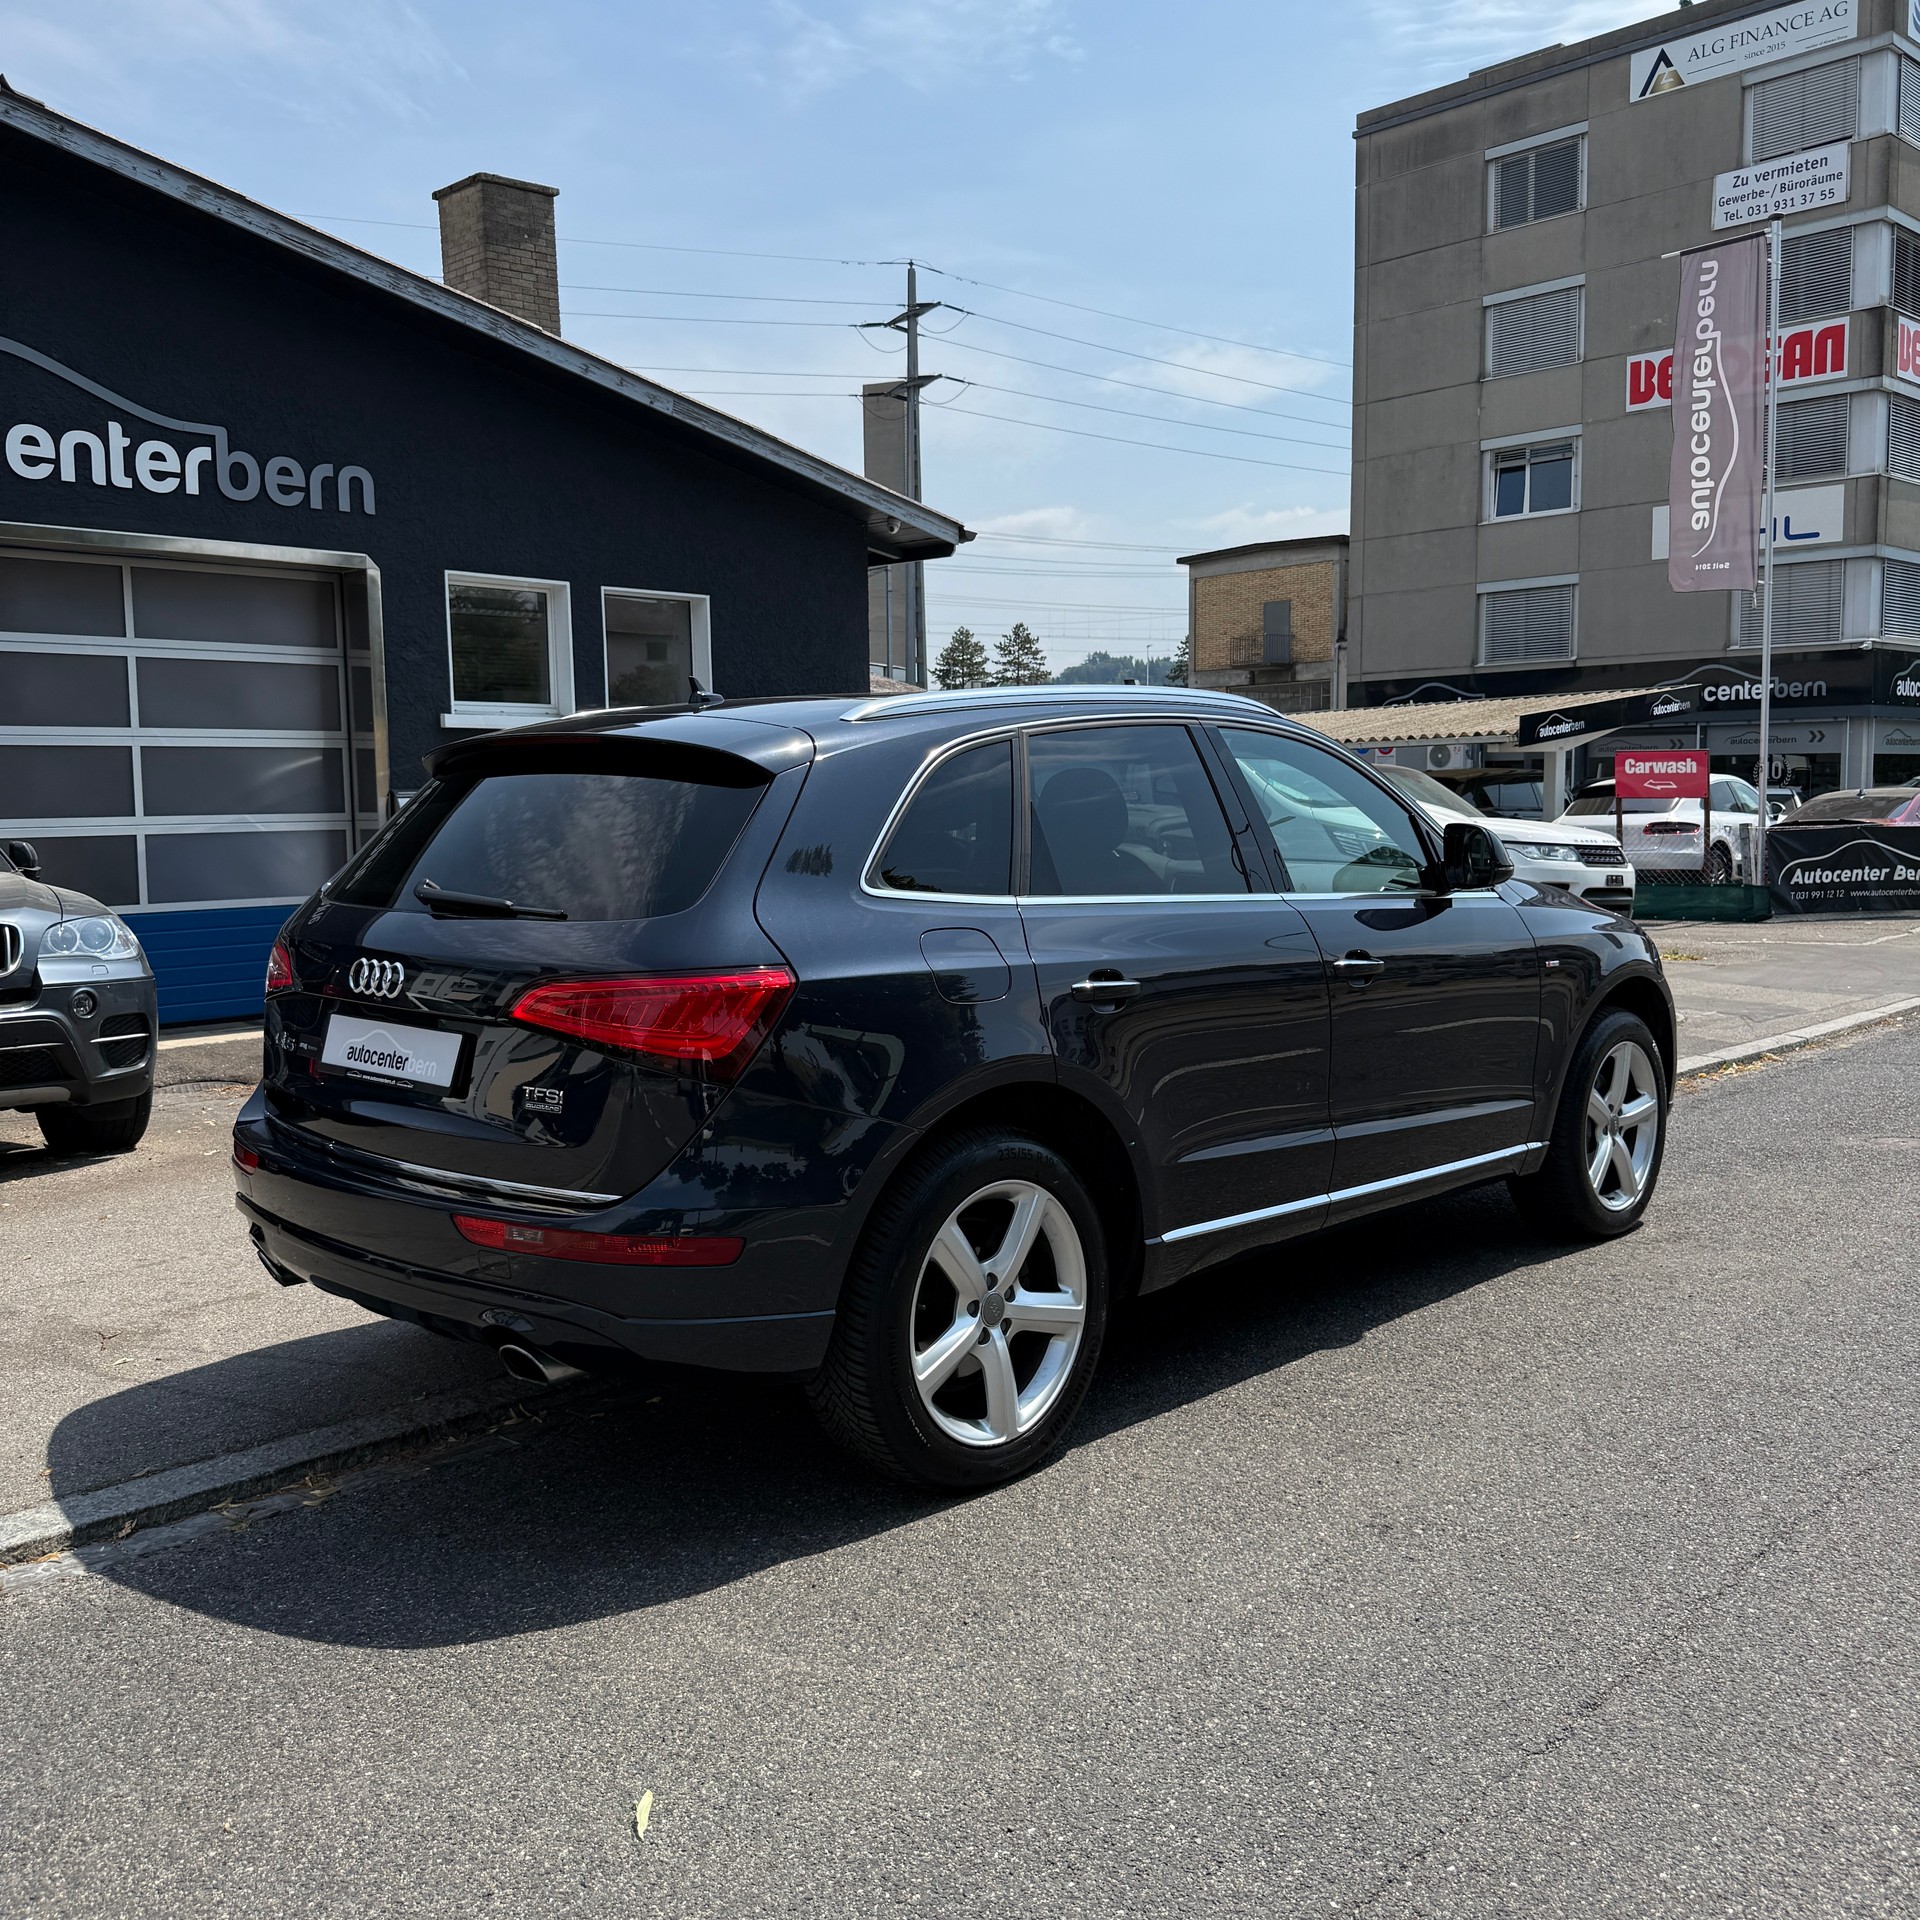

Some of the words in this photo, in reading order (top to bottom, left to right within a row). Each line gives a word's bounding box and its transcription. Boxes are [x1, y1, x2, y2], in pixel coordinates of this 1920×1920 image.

[1687, 38, 1725, 63] ALG
[1729, 11, 1815, 51] FINANCE
[1819, 0, 1849, 23] AG
[1744, 47, 1765, 60] since
[1766, 41, 1786, 55] 2015
[1732, 175, 1749, 188] Zu
[1754, 156, 1828, 183] vermieten
[1724, 211, 1743, 222] Tel.
[1747, 203, 1769, 217] 031
[1773, 197, 1795, 212] 931
[1800, 192, 1815, 206] 37
[1820, 188, 1835, 201] 55
[1652, 701, 1691, 716] autocenterbern
[1539, 720, 1585, 738] autocenterbern
[1730, 737, 1797, 745] autoceerbern
[1624, 758, 1697, 775] Carwash
[1790, 865, 1891, 885] Autocenter
[1796, 891, 1809, 900] 031
[1810, 890, 1824, 899] 991
[1826, 890, 1834, 898] 12
[1836, 889, 1845, 898] 12
[346, 1044, 437, 1078] autocenterbern
[522, 1085, 563, 1104] TFSI
